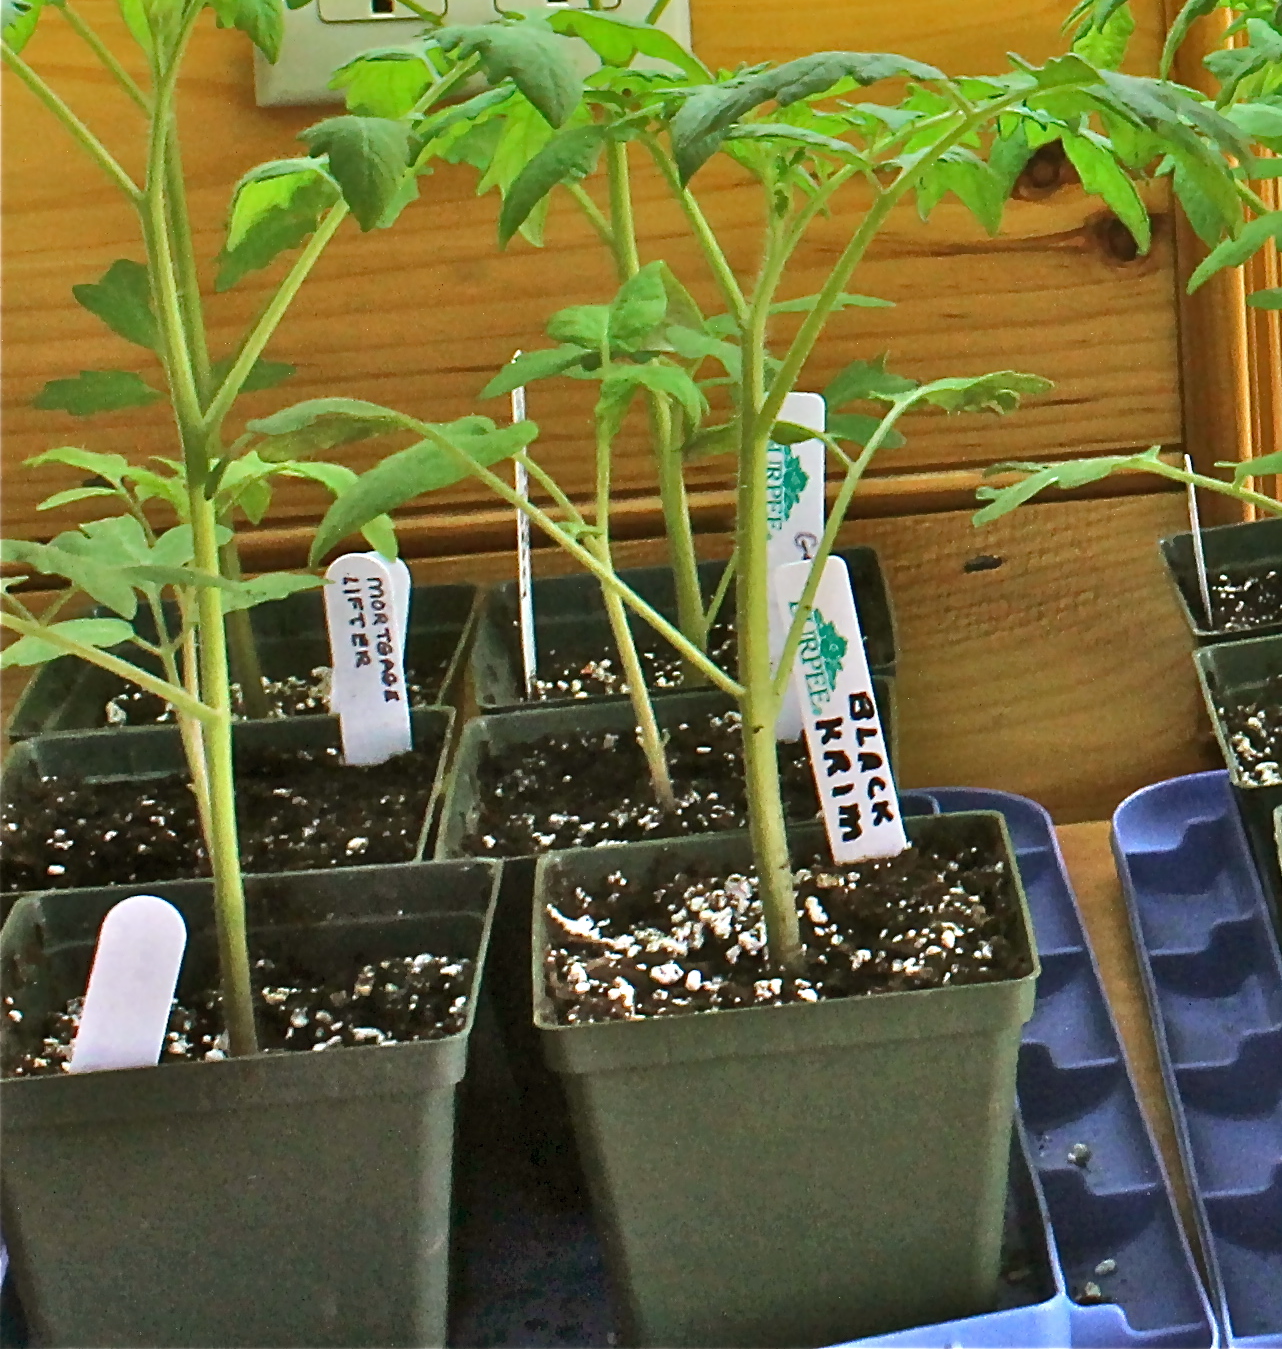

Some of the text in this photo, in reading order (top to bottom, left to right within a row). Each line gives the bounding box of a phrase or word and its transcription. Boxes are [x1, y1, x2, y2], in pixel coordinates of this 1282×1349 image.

[341, 576, 372, 669] LIFTER
[366, 576, 401, 703] MORTGAGE
[814, 716, 864, 843] KRIM
[848, 690, 895, 827] BLACK
